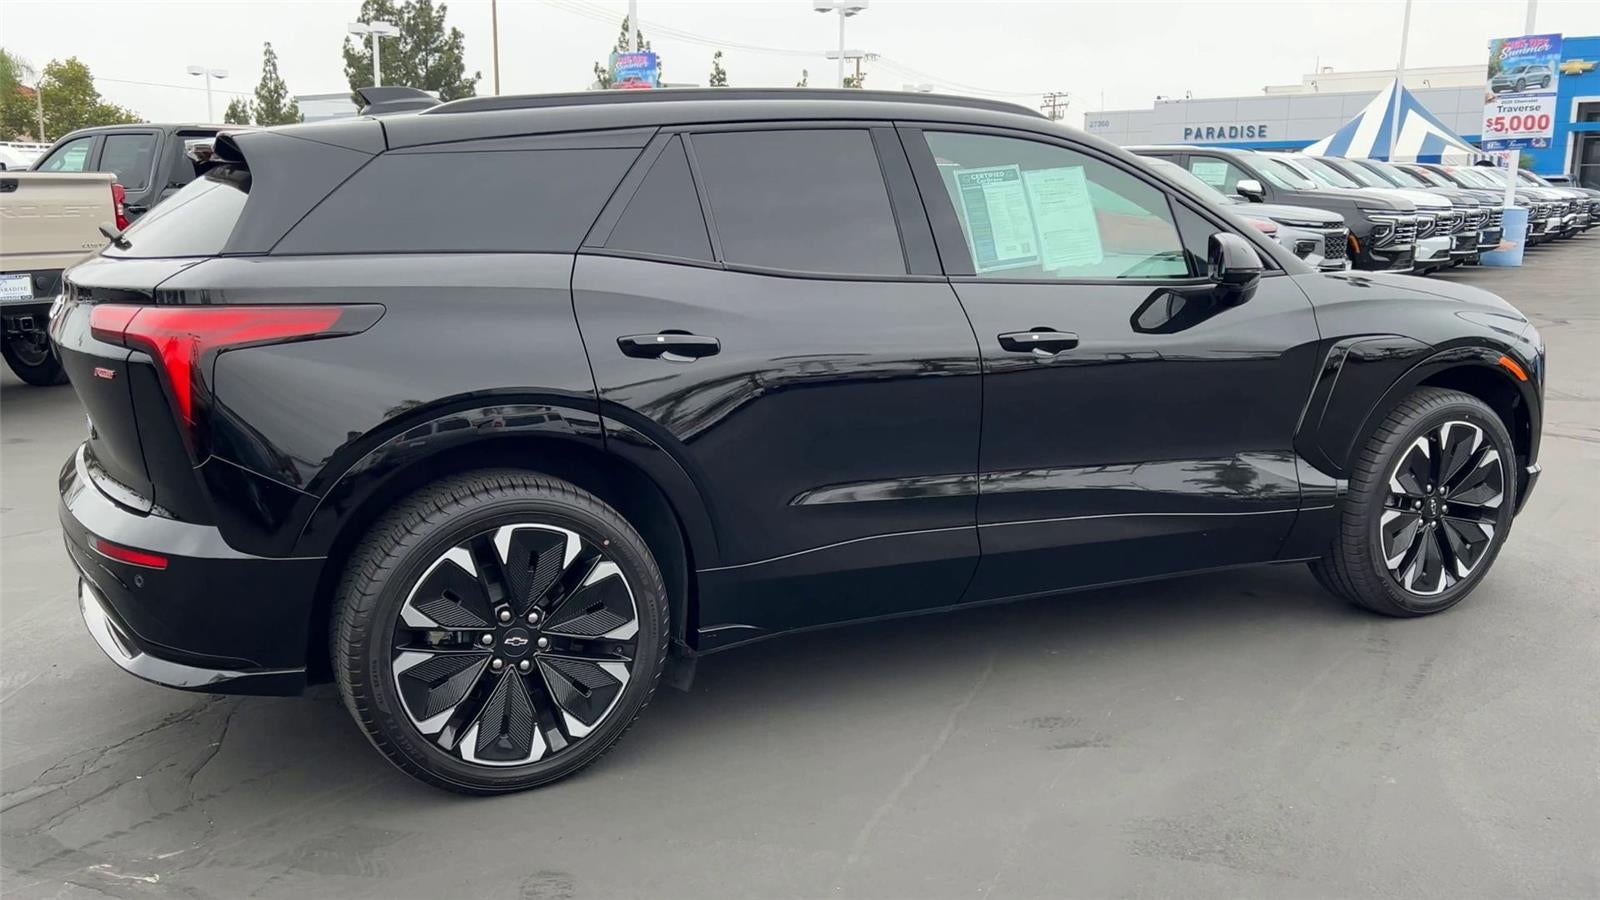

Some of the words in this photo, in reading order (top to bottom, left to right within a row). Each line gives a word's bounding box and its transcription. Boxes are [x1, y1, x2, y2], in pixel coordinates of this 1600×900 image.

[1499, 43, 1553, 60] Summer
[1496, 103, 1542, 114] Traverse
[1184, 124, 1268, 141] PARADISE
[1486, 114, 1551, 134] $5,000
